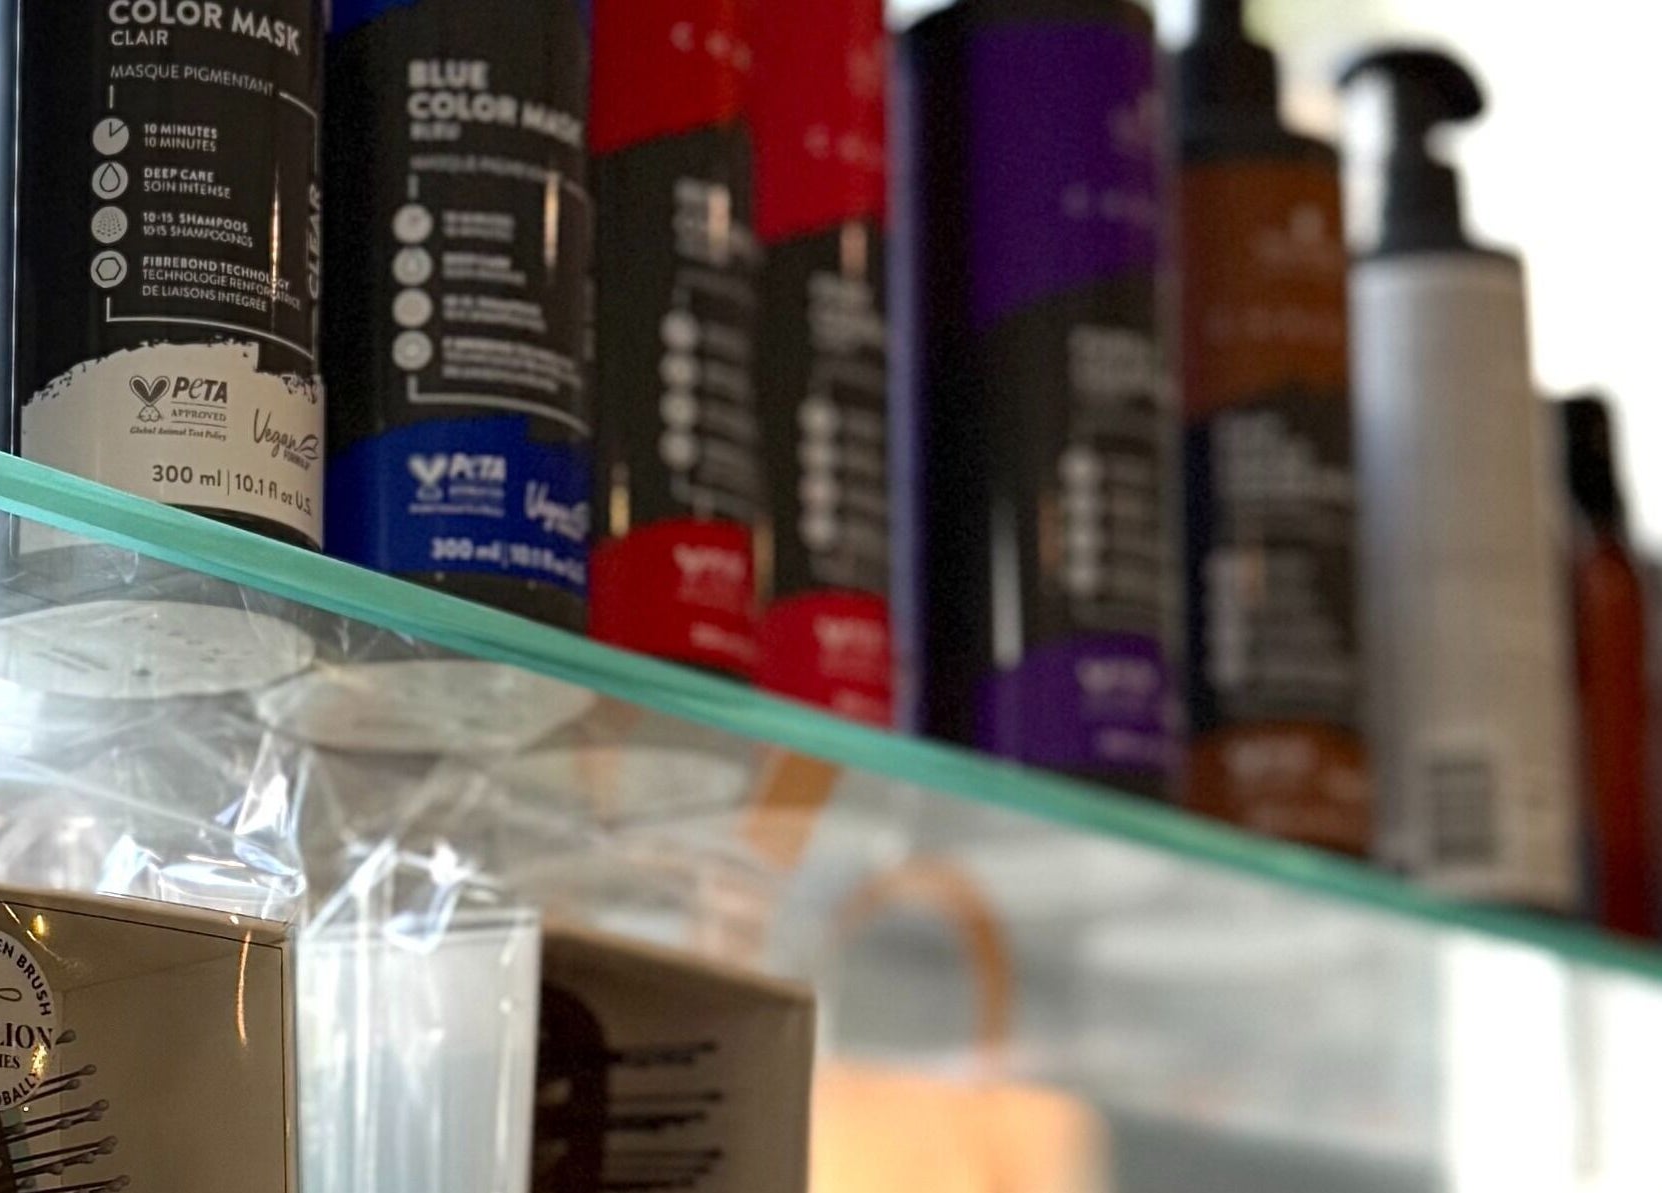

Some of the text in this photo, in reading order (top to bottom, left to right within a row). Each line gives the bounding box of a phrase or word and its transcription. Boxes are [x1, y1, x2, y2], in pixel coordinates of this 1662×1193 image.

[108, 0, 301, 56] COLOR MASK
[110, 29, 169, 46] CLAIR
[110, 64, 275, 97] MASQUE PIGMENTANT
[408, 58, 490, 90] BLUE
[406, 89, 519, 126] COLOR
[144, 123, 218, 140] 10 MINUTES
[144, 136, 217, 153] 10 MINUTES
[144, 167, 214, 183] DEEP CARE
[143, 181, 231, 200] SOIN INTENSE
[143, 211, 248, 234] 10-15 SHAMPOOS
[142, 268, 228, 287] TECHNOLOGIE
[143, 256, 291, 291] FIBREBOND TECHNOLGY
[161, 286, 216, 301] LIAISONS
[171, 408, 227, 422] APPROVED
[253, 408, 298, 458] Vegan
[152, 464, 193, 485] 300
[199, 468, 221, 487] ml
[235, 473, 264, 496] 10.1
[269, 480, 278, 500] fl
[281, 491, 293, 505] oz
[16, 953, 51, 1016] BRUSH
